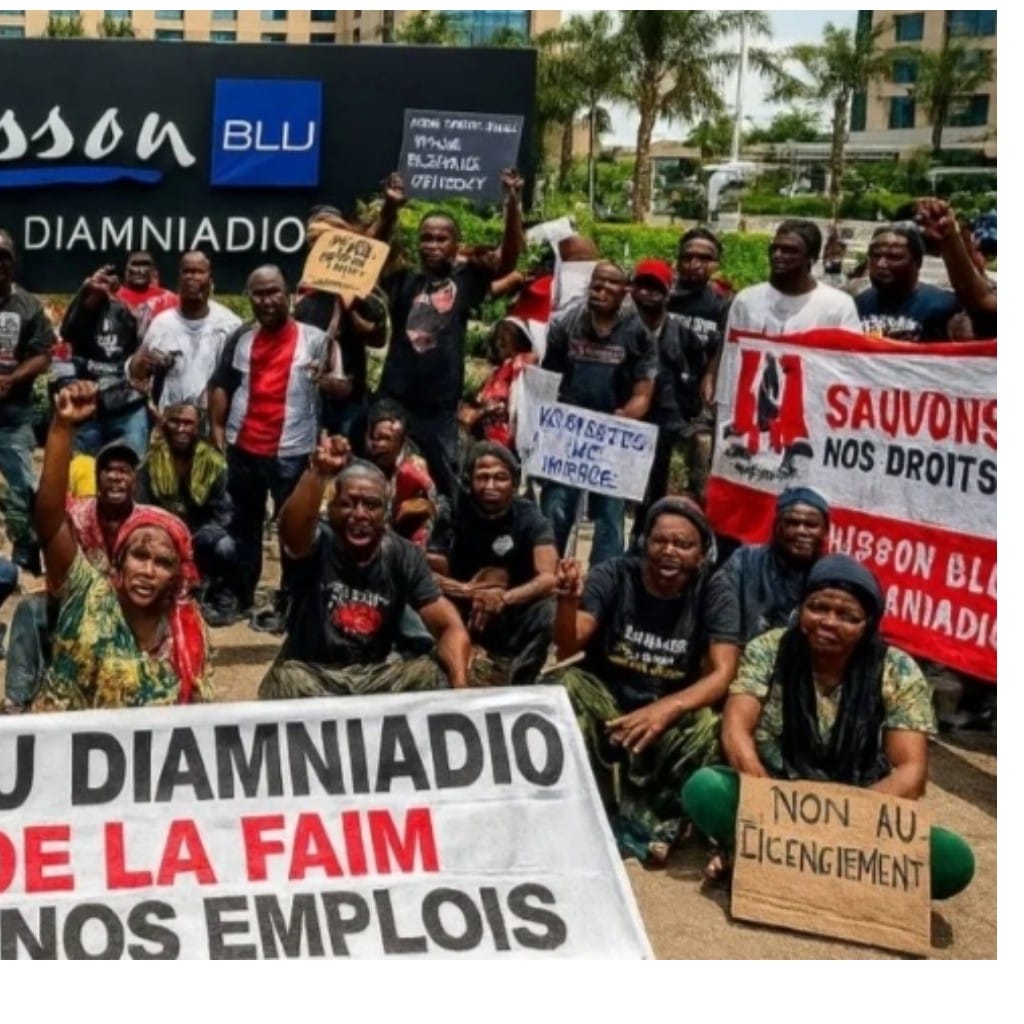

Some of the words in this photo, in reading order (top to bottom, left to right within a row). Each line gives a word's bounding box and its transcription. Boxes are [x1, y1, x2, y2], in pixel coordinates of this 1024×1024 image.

[221, 118, 317, 153] BLU
[23, 215, 306, 254] DIAMNIADIO
[825, 383, 998, 451] SAUVONS
[823, 437, 876, 472] NOS
[885, 444, 998, 496] DROITS
[72, 712, 565, 807] DIAMNIADIO
[771, 785, 850, 827] NON
[876, 803, 917, 843] AU
[104, 818, 218, 891] LA
[241, 807, 440, 882] FAIM
[0, 899, 181, 960] NOS
[203, 882, 568, 960] EMPLOIS
